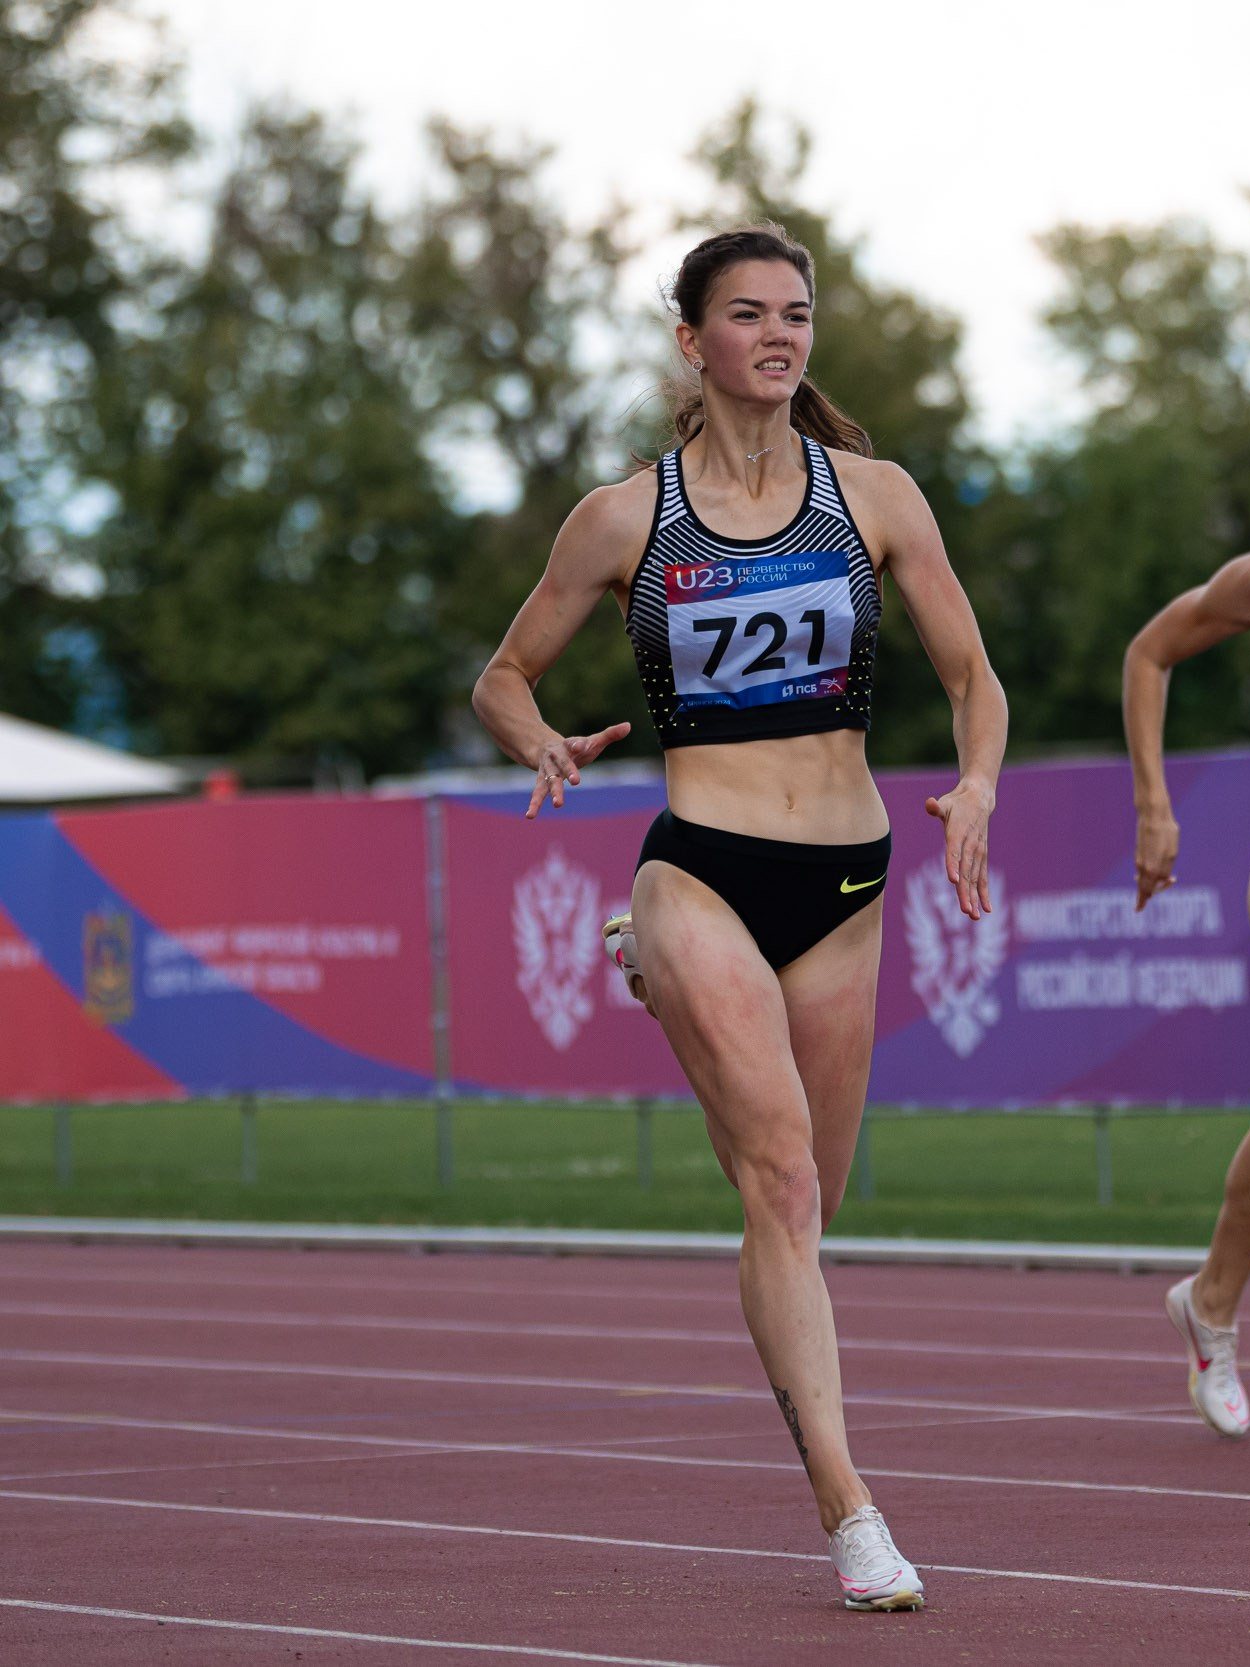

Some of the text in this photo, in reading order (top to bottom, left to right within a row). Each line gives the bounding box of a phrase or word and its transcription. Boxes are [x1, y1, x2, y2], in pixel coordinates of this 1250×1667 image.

[737, 561, 815, 576] ПЕРВЕНСТВО
[676, 566, 734, 590] U23
[737, 572, 788, 585] РОССИИ
[692, 608, 825, 680] 721
[795, 683, 818, 696] ПСБ
